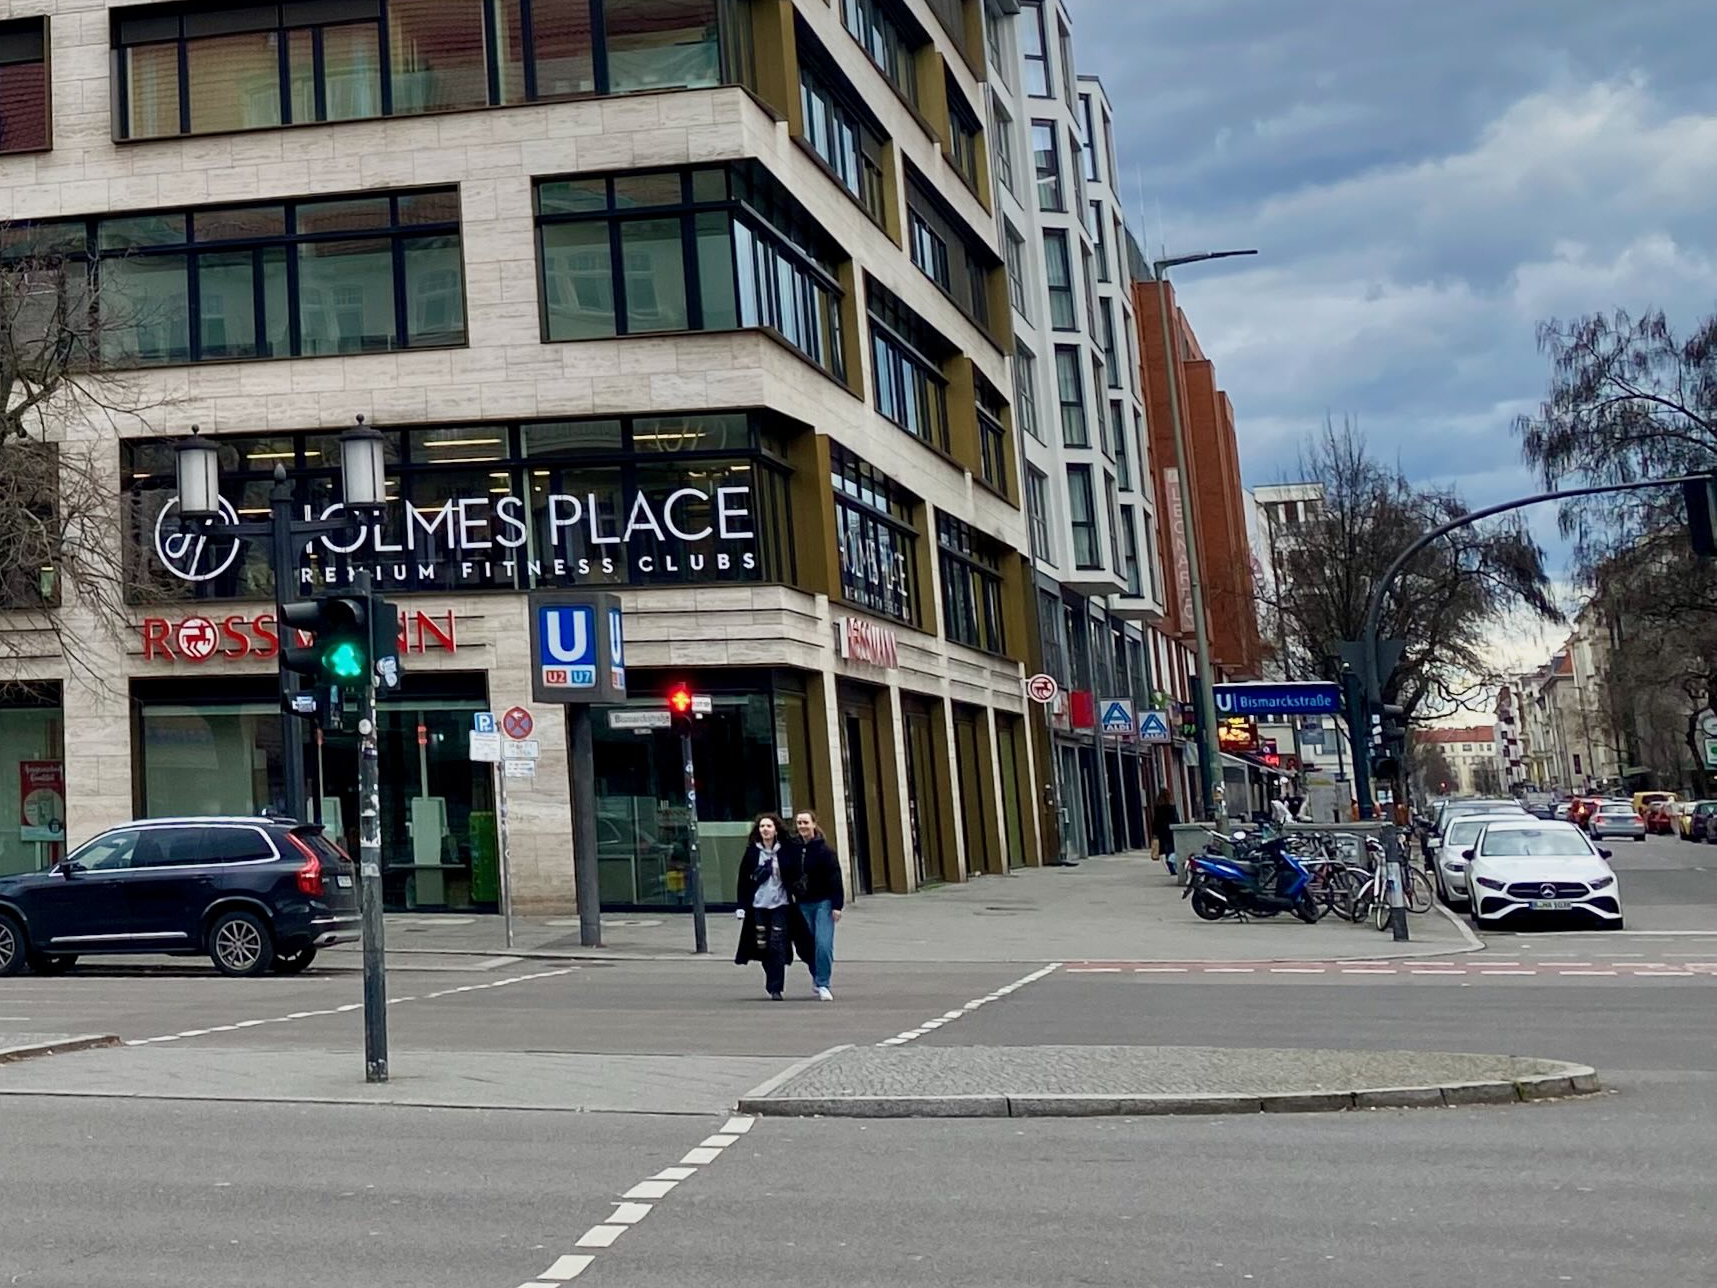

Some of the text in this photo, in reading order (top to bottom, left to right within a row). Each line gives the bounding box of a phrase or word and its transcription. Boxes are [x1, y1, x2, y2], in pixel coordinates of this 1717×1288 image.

[548, 486, 754, 546] PLACE
[301, 552, 756, 583] REIUM FITNESS CLUBS
[143, 608, 458, 662] ROSSN
[547, 611, 587, 662] U
[608, 612, 622, 664] U
[546, 671, 566, 683] U2
[573, 671, 592, 683] U7
[1216, 693, 1332, 712] U Bismarckstraße
[1105, 723, 1132, 732] ALDI
[1142, 732, 1166, 740] ALDI
